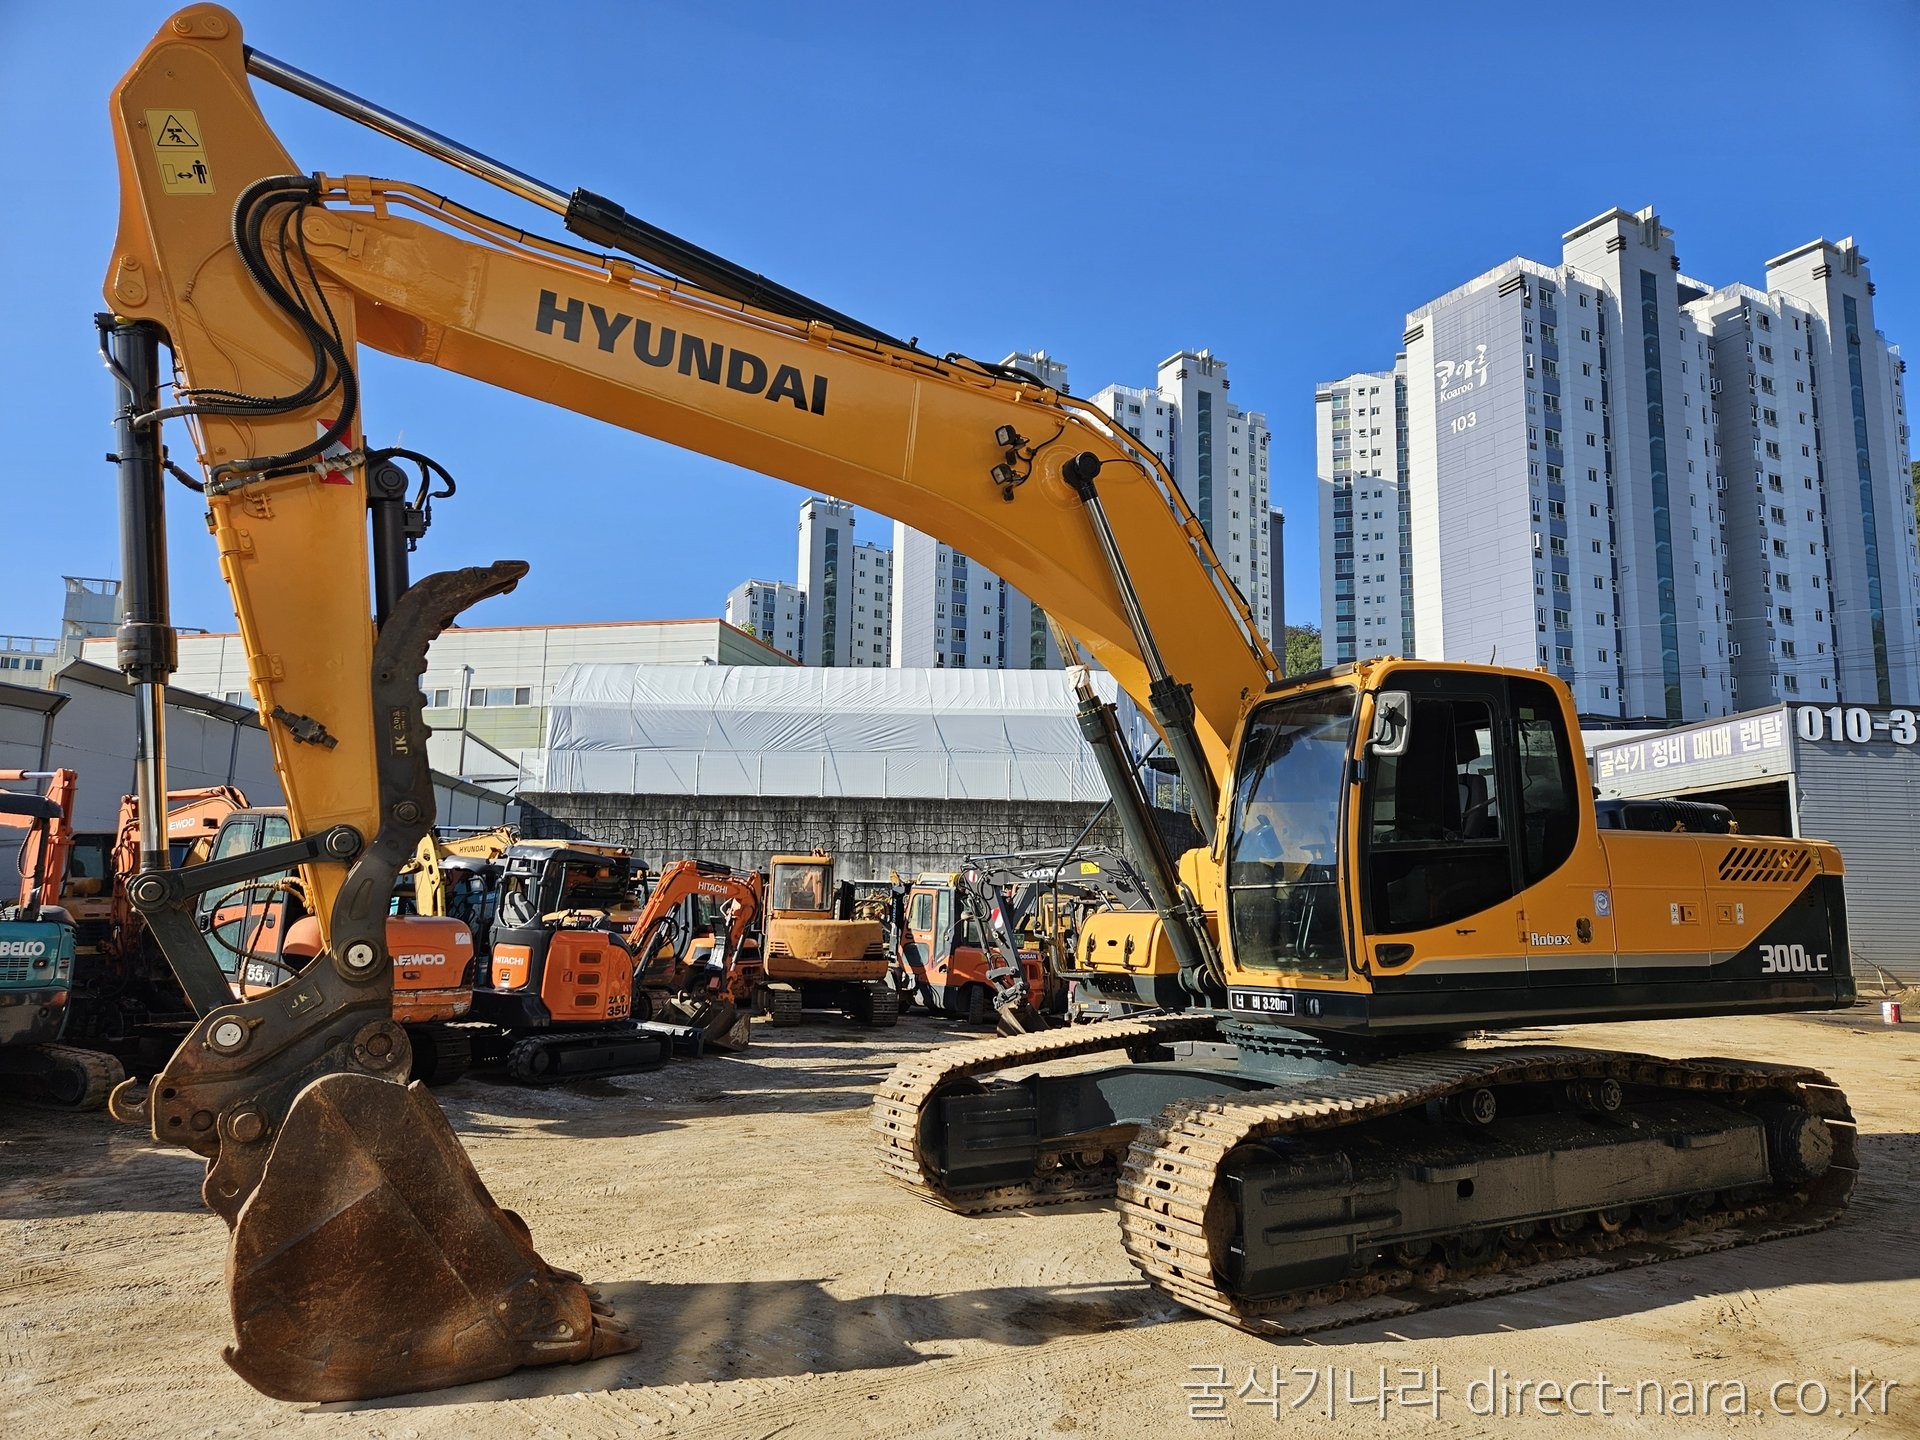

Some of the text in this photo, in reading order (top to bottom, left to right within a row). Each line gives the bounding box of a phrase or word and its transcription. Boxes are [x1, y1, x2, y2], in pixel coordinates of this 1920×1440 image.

[536, 288, 828, 416] HYUNDAI
[1435, 344, 1490, 389] 코아루
[1440, 381, 1473, 403] Koaroo
[1450, 411, 1477, 434] 103
[1797, 706, 1920, 744] 010-3
[395, 736, 408, 754] JK
[1600, 715, 1783, 777] 굴삭기 정비 매매 렌탈
[168, 817, 195, 830] EWOO
[459, 844, 486, 853] HYUNDAI
[698, 881, 728, 895] HITACHI
[1530, 932, 1571, 946] Robex
[0, 941, 45, 956] BELCO
[494, 956, 524, 966] HITACHI
[1101, 1004, 1112, 1012] 55
[1236, 994, 1288, 1011] 너 비 3.20m
